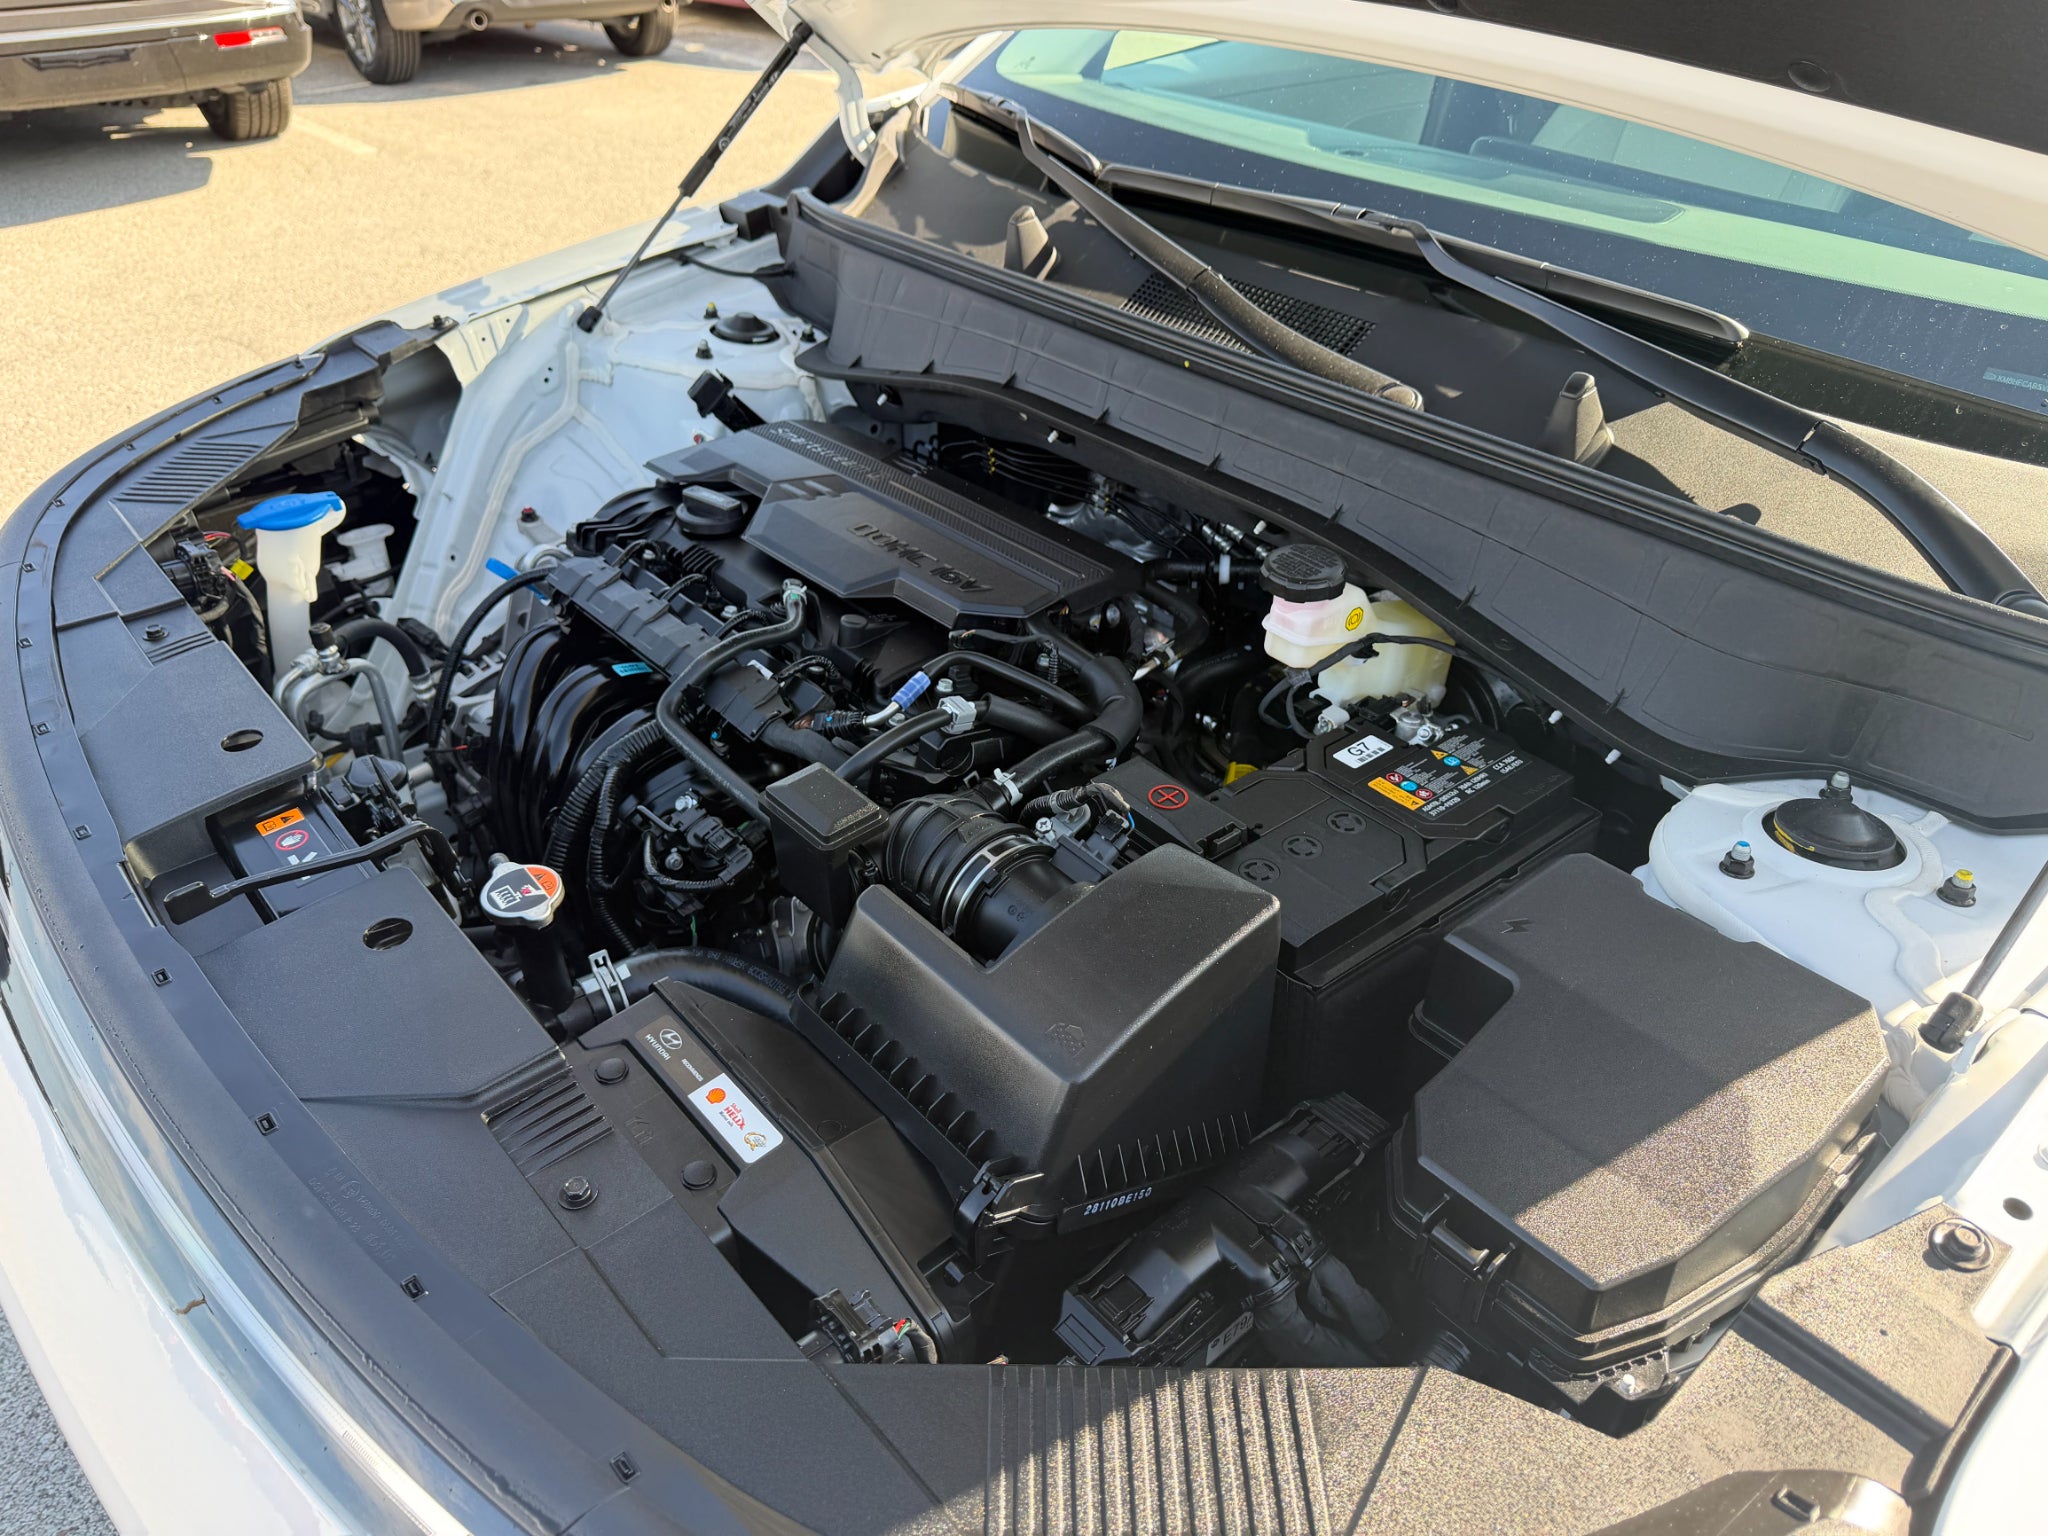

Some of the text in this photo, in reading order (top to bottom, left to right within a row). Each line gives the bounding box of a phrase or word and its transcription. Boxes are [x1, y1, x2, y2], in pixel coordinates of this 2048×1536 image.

[1347, 741, 1370, 757] G7
[645, 1033, 672, 1061] HYUNDAI
[723, 1106, 746, 1131] HELIX
